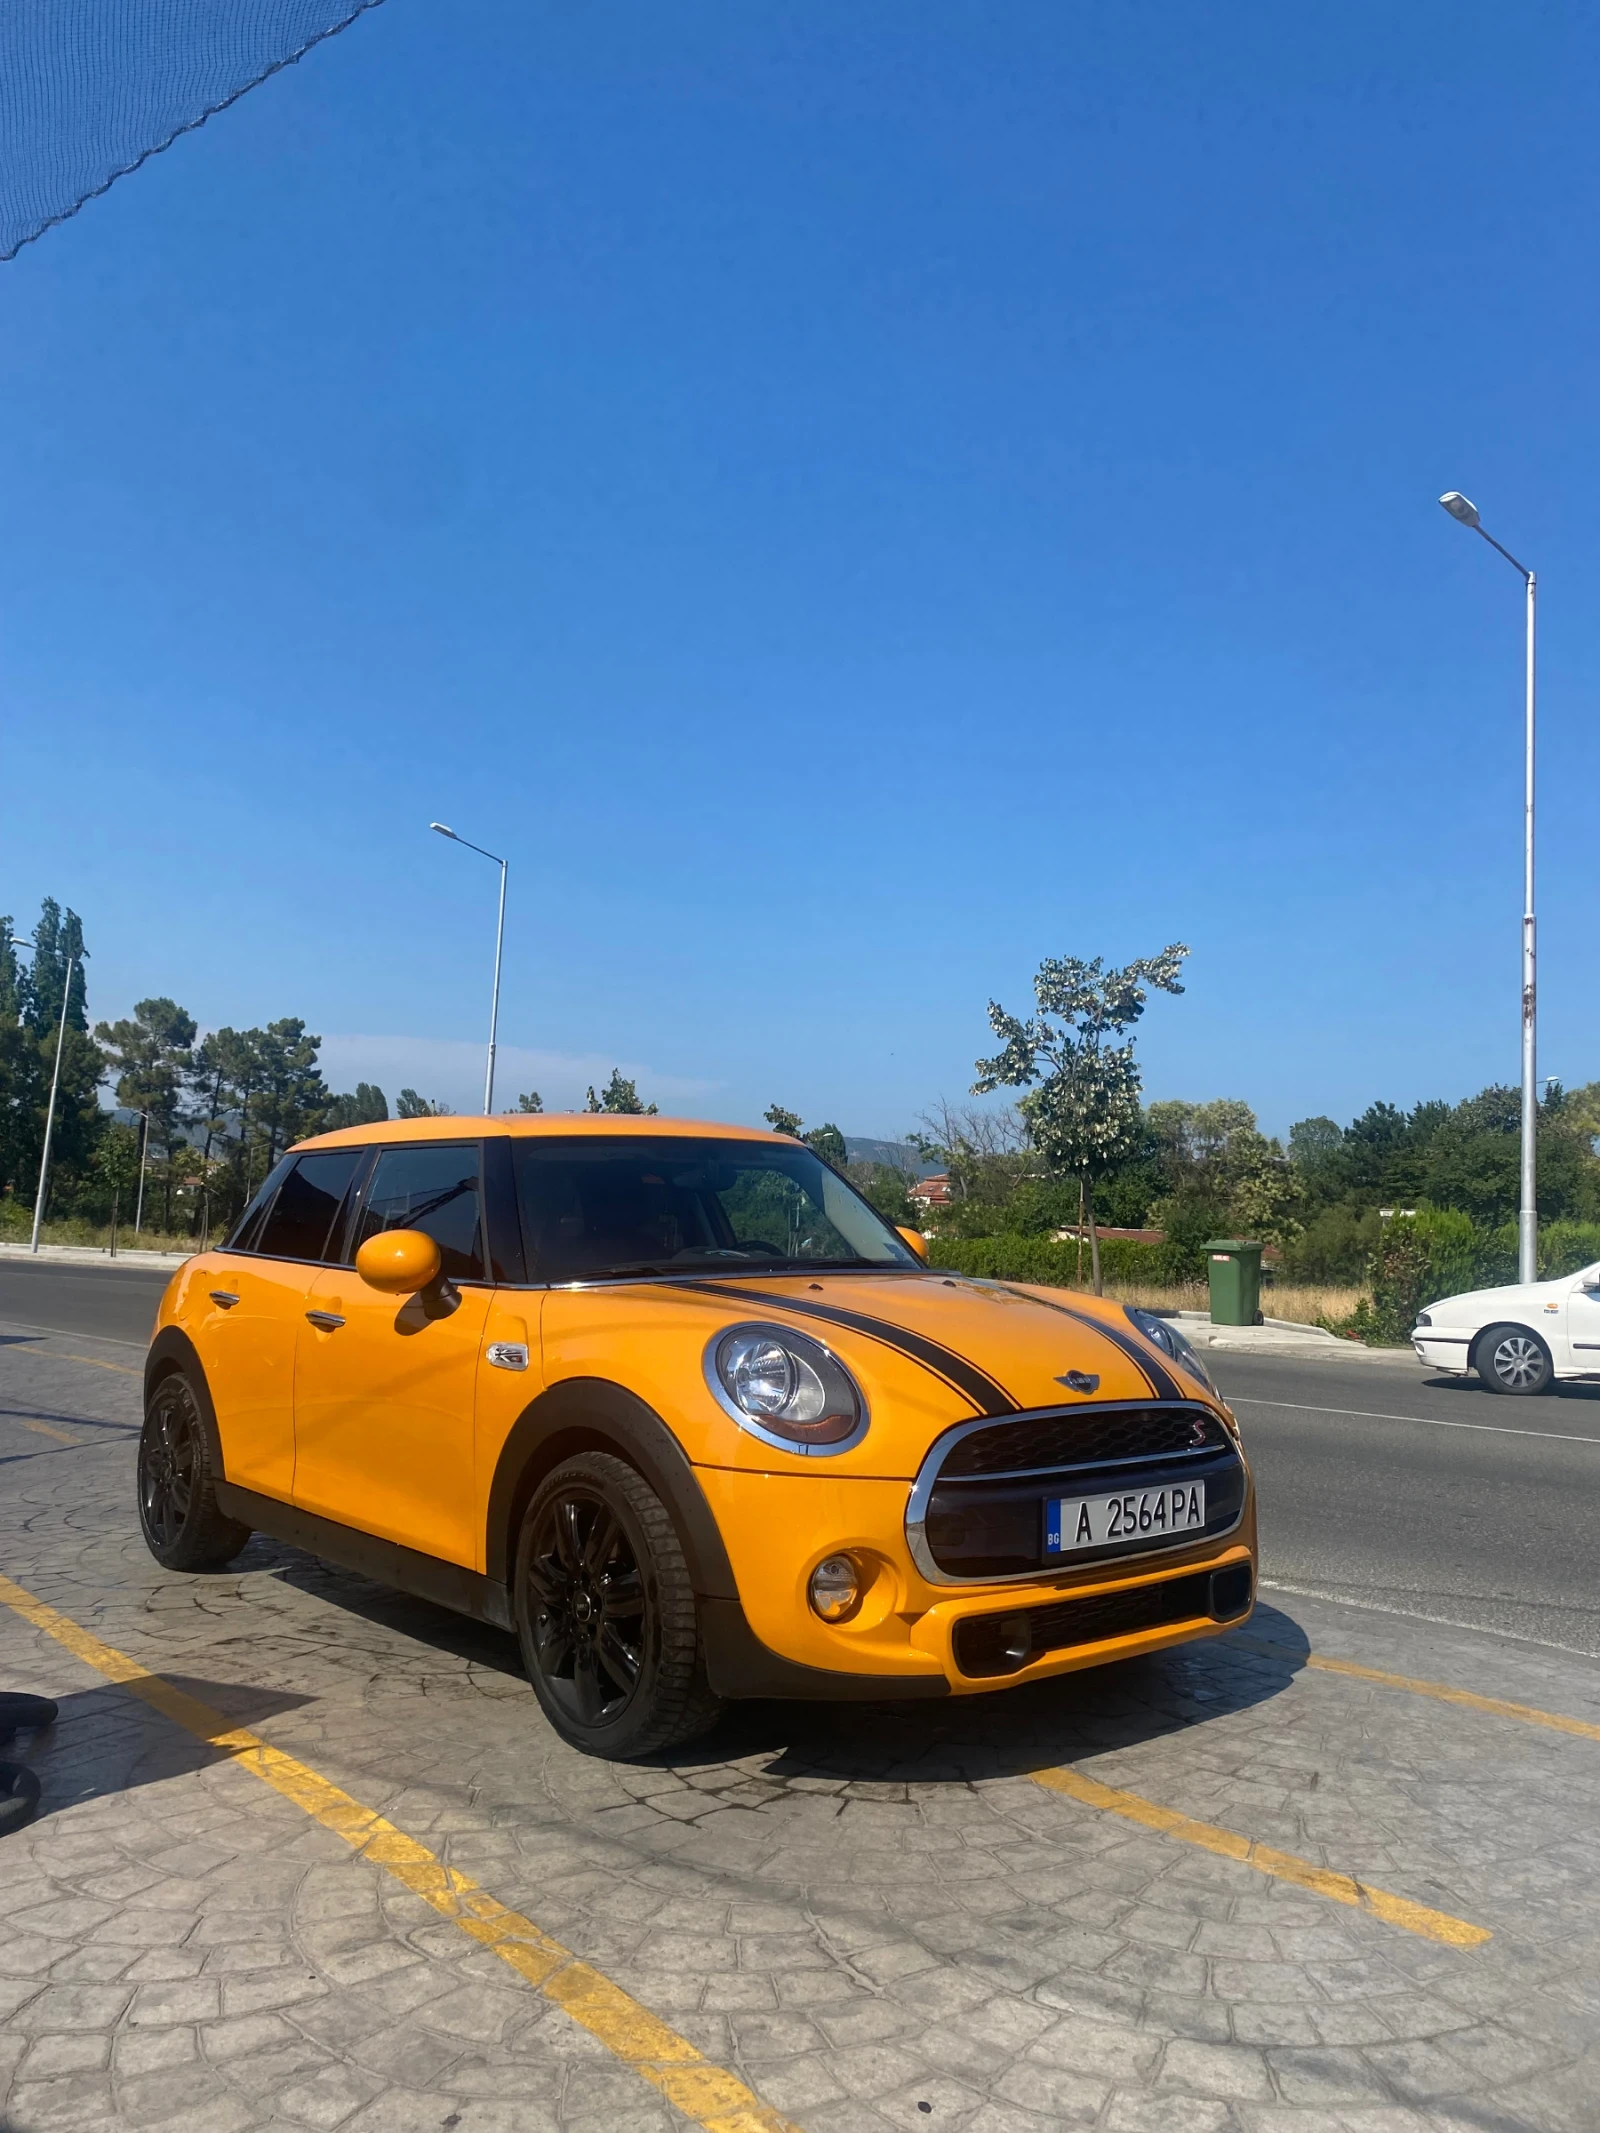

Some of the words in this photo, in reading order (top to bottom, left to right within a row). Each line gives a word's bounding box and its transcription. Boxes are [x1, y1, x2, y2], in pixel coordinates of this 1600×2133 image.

[1192, 1419, 1206, 1446] S
[1075, 1502, 1093, 1543] A
[1048, 1533, 1060, 1545] BG
